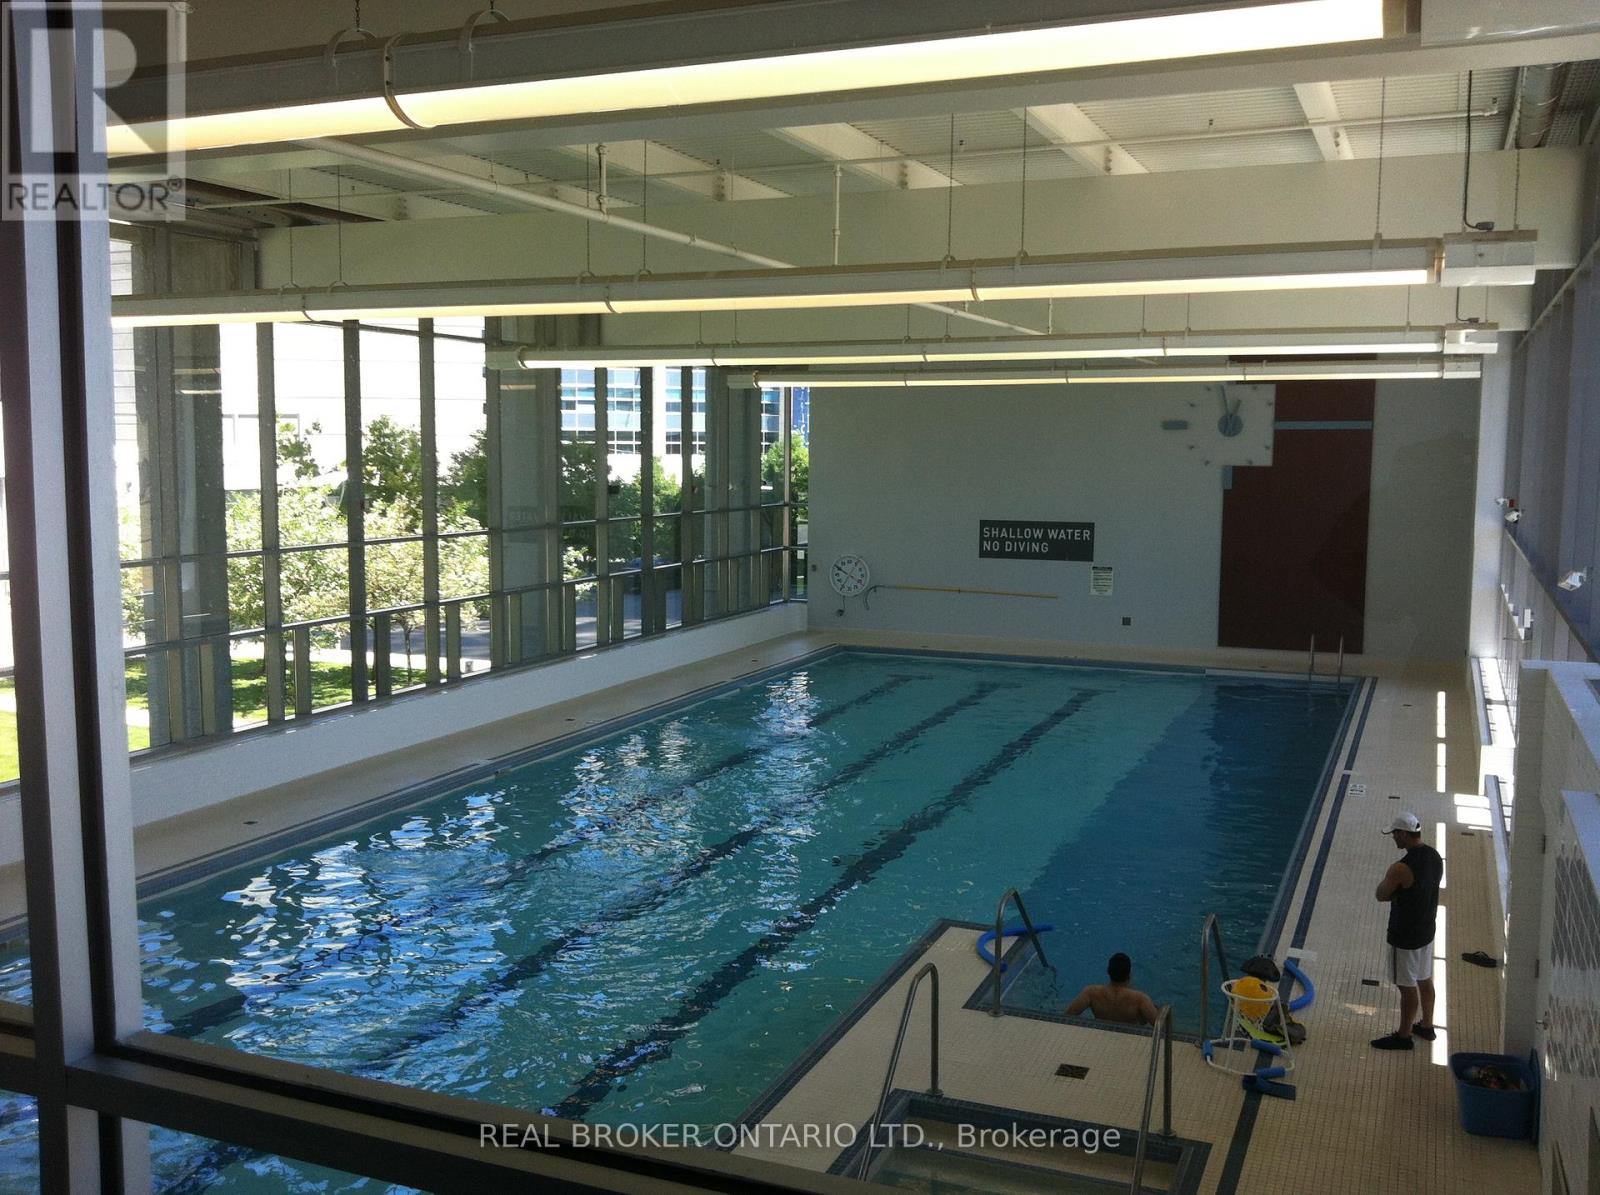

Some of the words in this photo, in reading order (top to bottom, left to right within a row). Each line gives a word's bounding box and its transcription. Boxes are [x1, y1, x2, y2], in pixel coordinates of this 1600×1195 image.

[982, 527, 1044, 540] SHALLOW
[1047, 529, 1091, 541] WATER
[982, 540, 1000, 552] NO
[1004, 541, 1049, 553] DIVING
